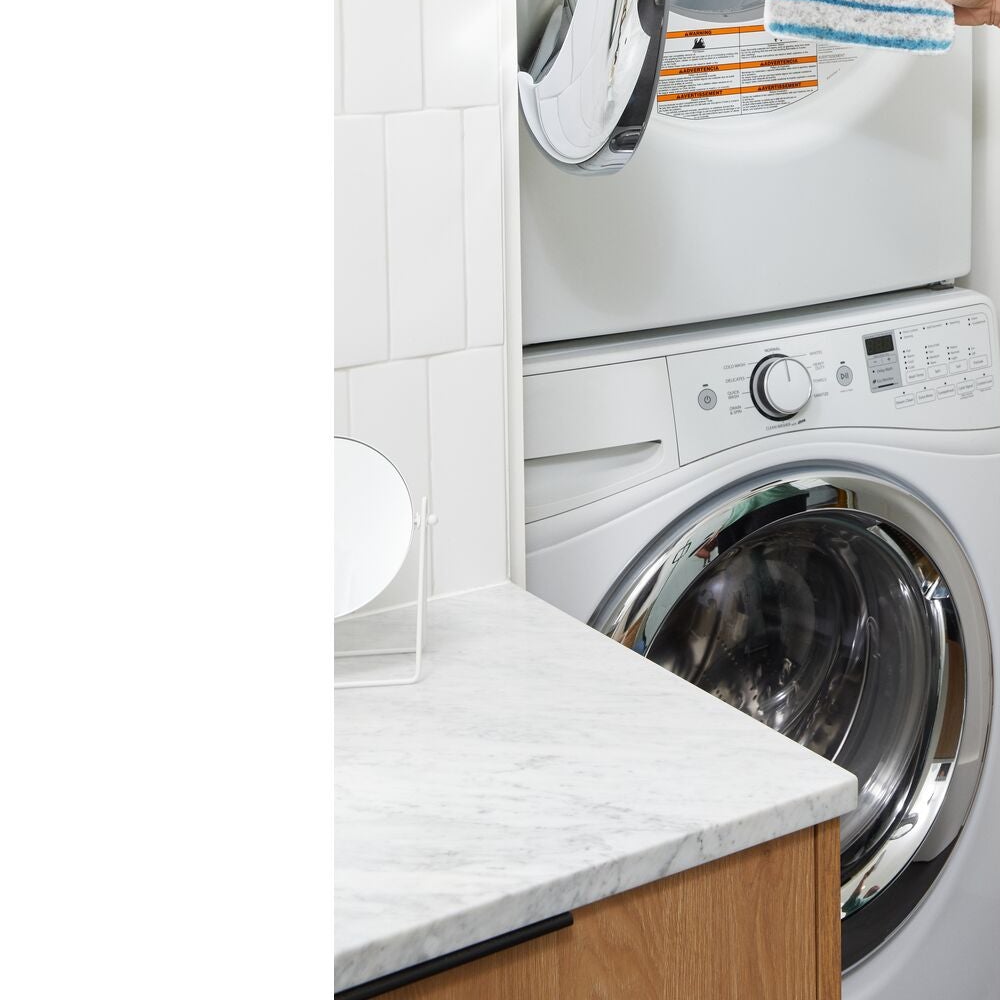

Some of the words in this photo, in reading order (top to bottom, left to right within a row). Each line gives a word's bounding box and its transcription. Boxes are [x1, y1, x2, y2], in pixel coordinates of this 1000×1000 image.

[765, 58, 798, 66] ADVERTENCIA
[683, 66, 720, 74] ADVERTENCIA
[681, 90, 723, 98] AVERTISSEMENT
